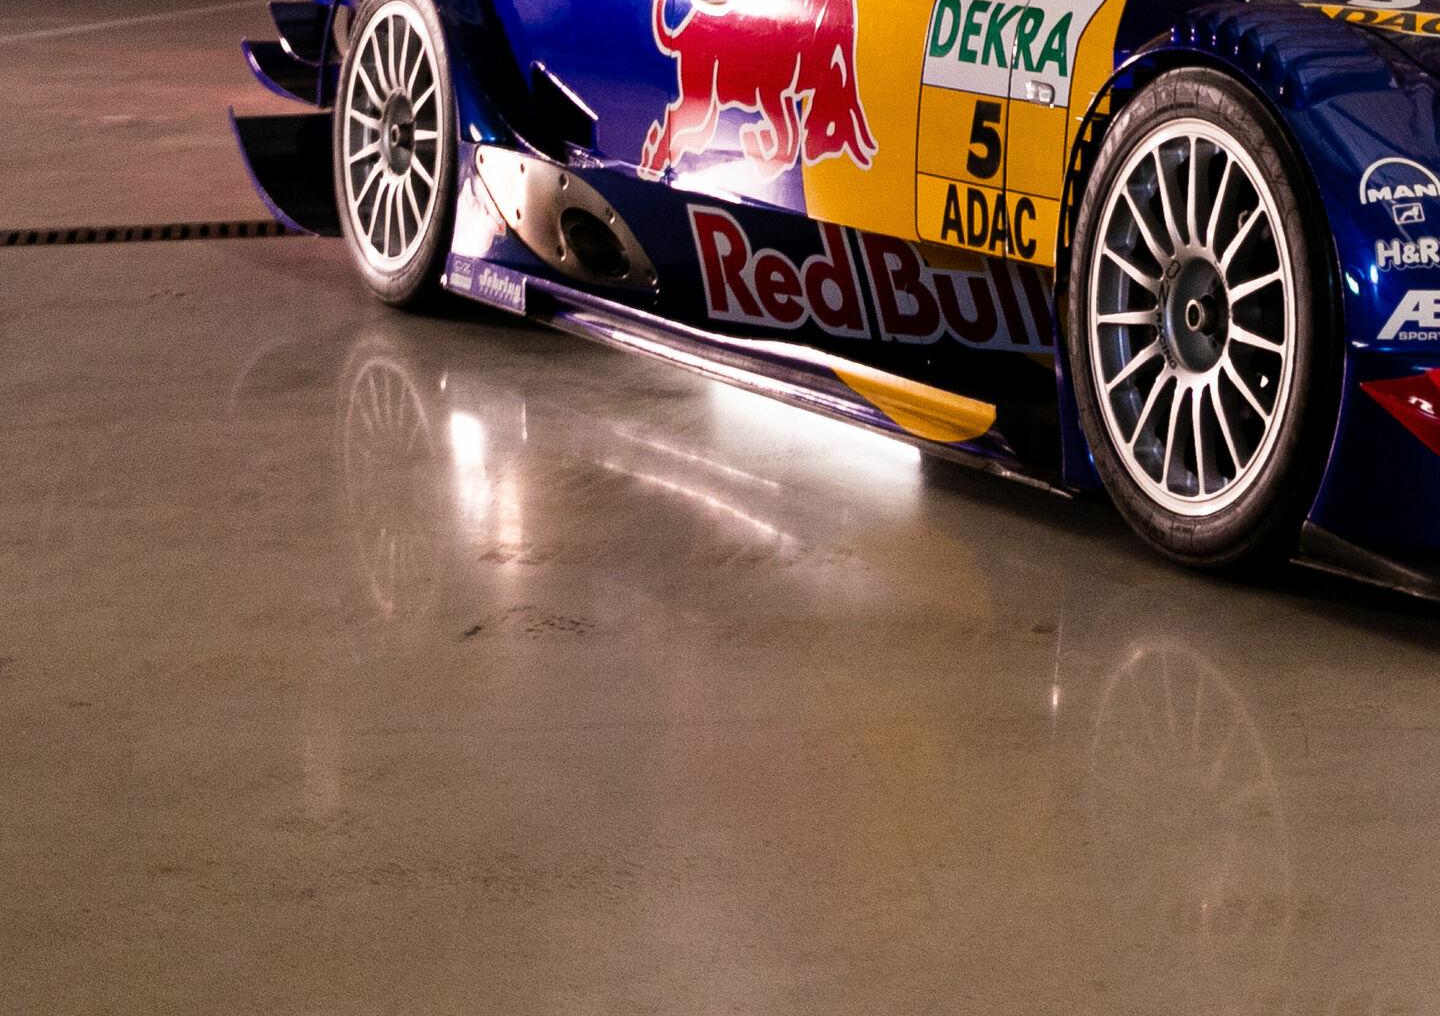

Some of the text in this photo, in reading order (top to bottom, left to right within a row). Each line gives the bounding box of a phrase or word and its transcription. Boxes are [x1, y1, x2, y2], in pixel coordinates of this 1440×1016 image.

[966, 100, 1002, 180] 5
[940, 183, 1037, 260] ADAC
[1367, 184, 1437, 203] MAN
